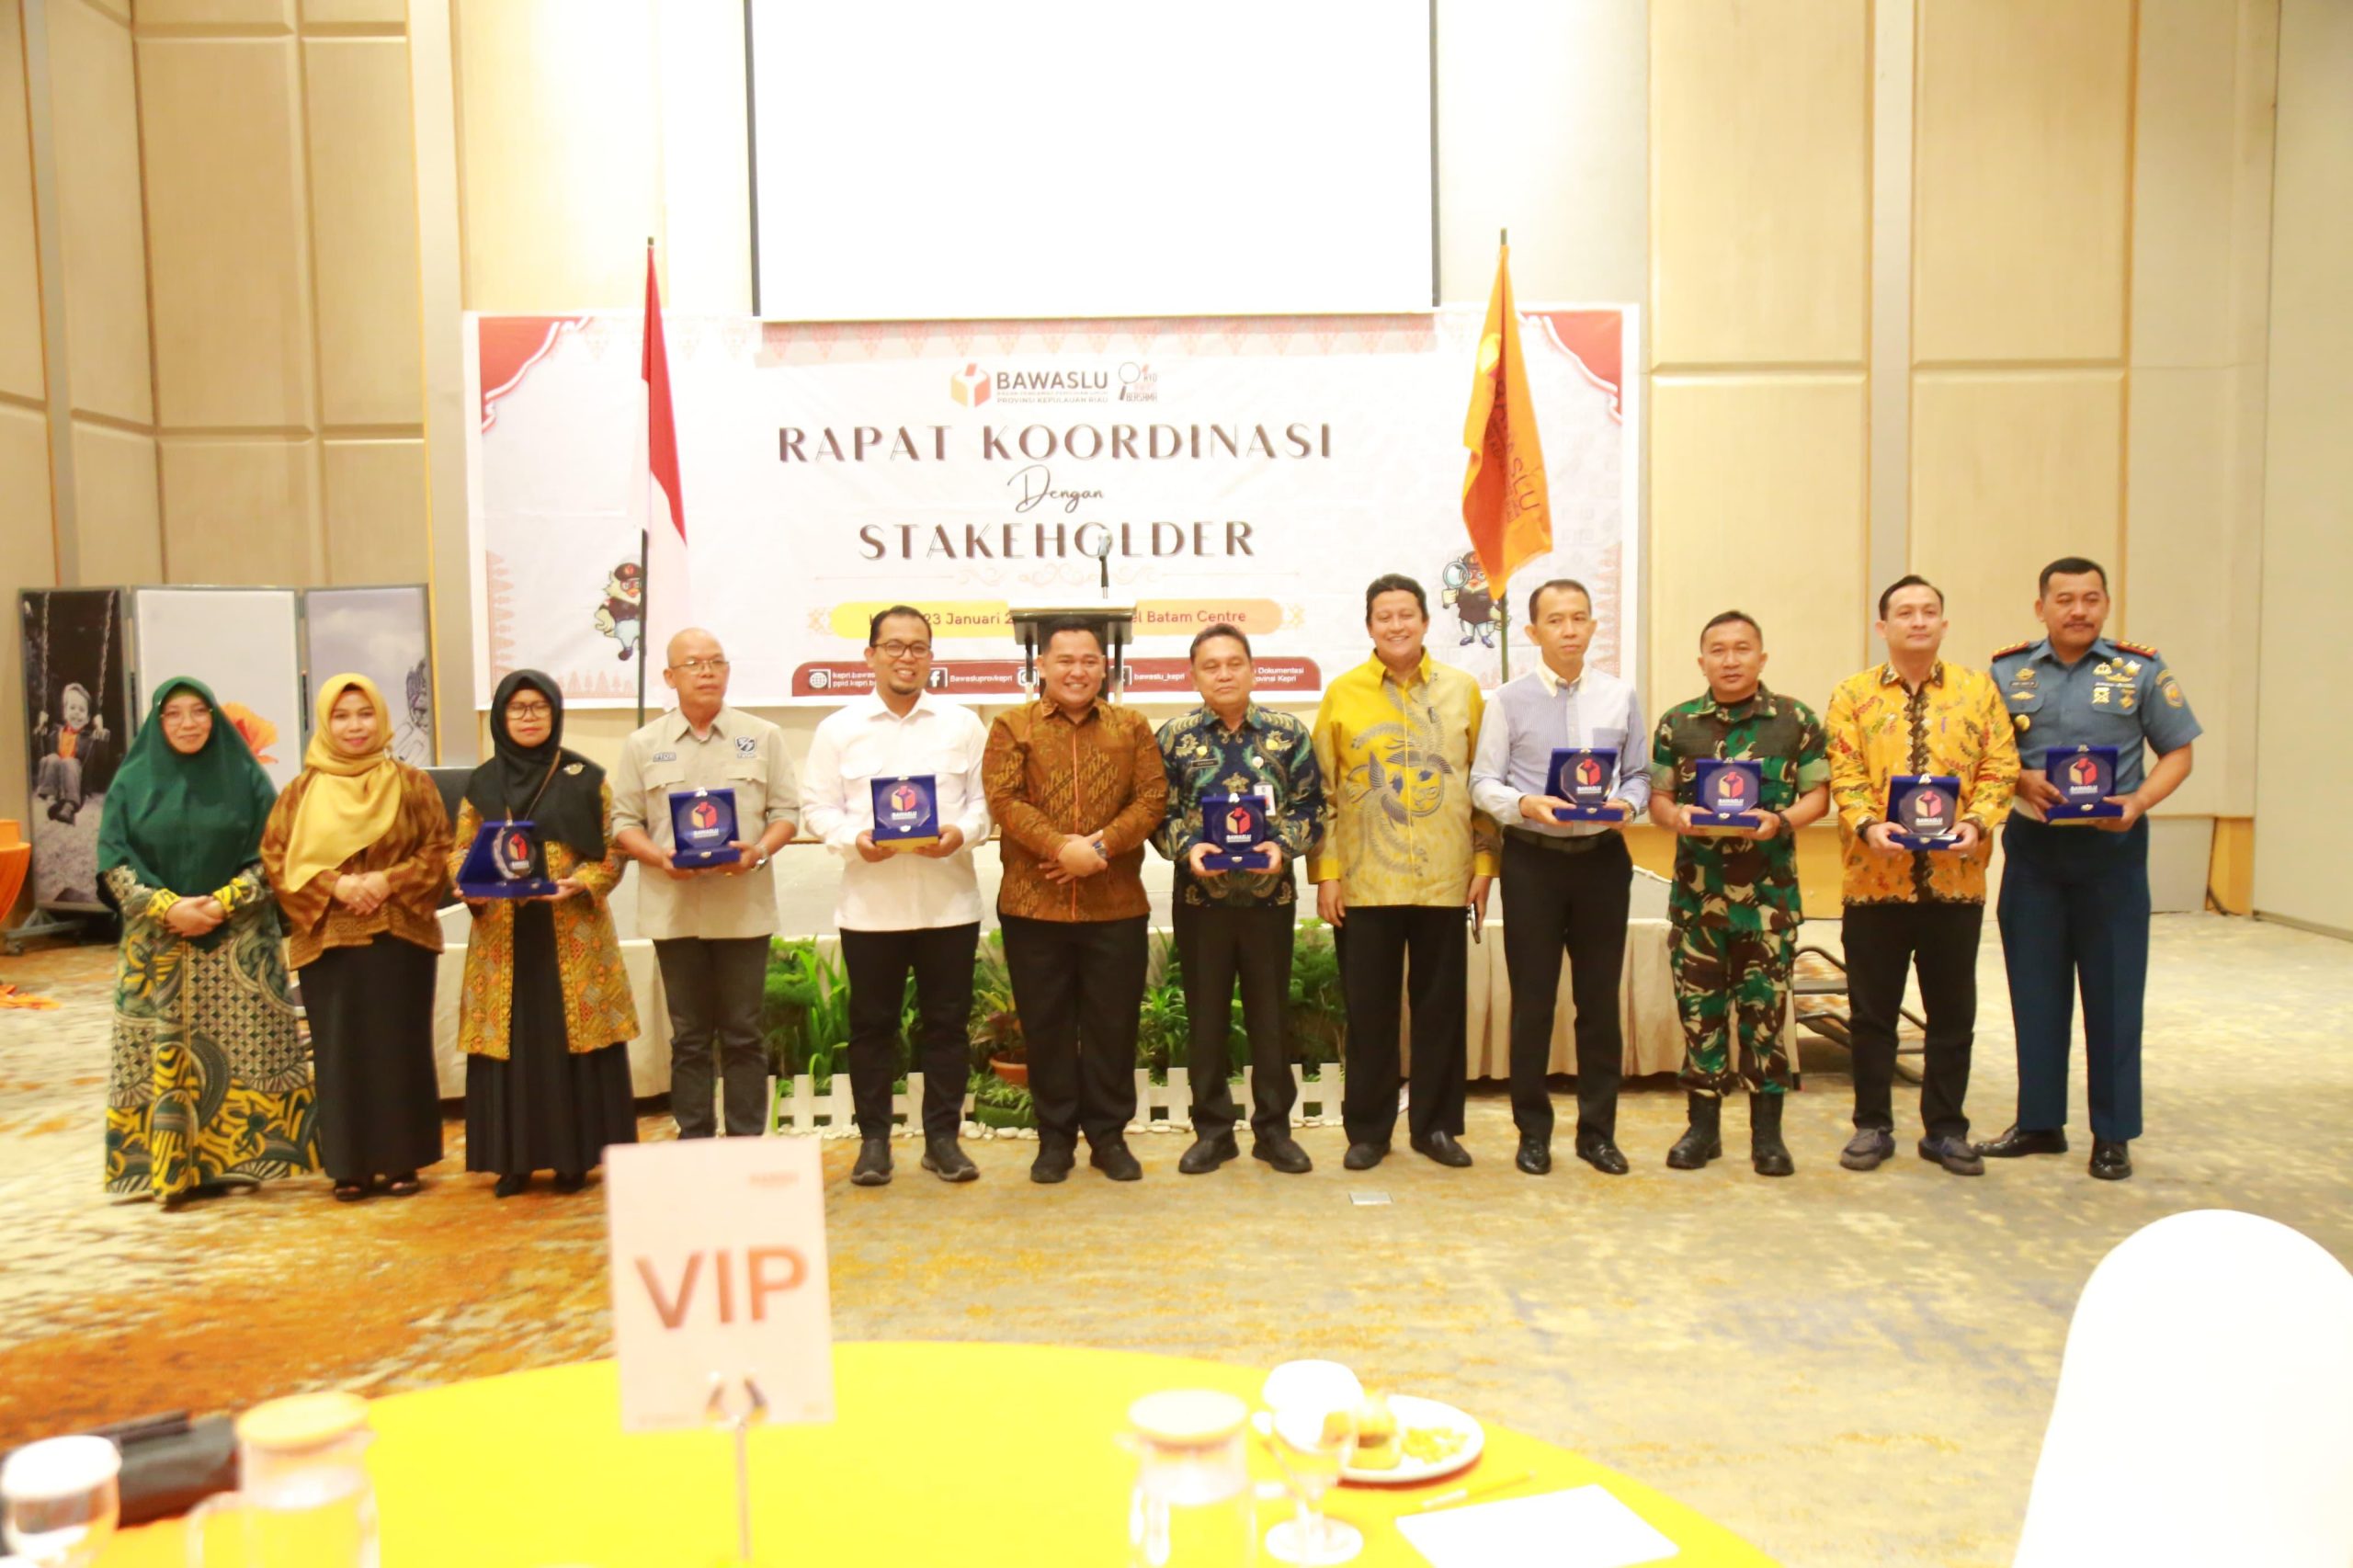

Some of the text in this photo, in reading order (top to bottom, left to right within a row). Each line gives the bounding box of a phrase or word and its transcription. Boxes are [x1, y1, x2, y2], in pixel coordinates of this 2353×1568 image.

[996, 371, 1108, 390] BAWASLU
[779, 423, 1332, 462] RAPAT KOORDINASI
[1006, 464, 1103, 513] Dengan
[858, 520, 1255, 560] STAKEHOLDER
[946, 611, 1000, 625] Januari
[1147, 610, 1192, 623] Batam
[1197, 609, 1246, 623] Centre
[633, 1244, 810, 1331] VIP
